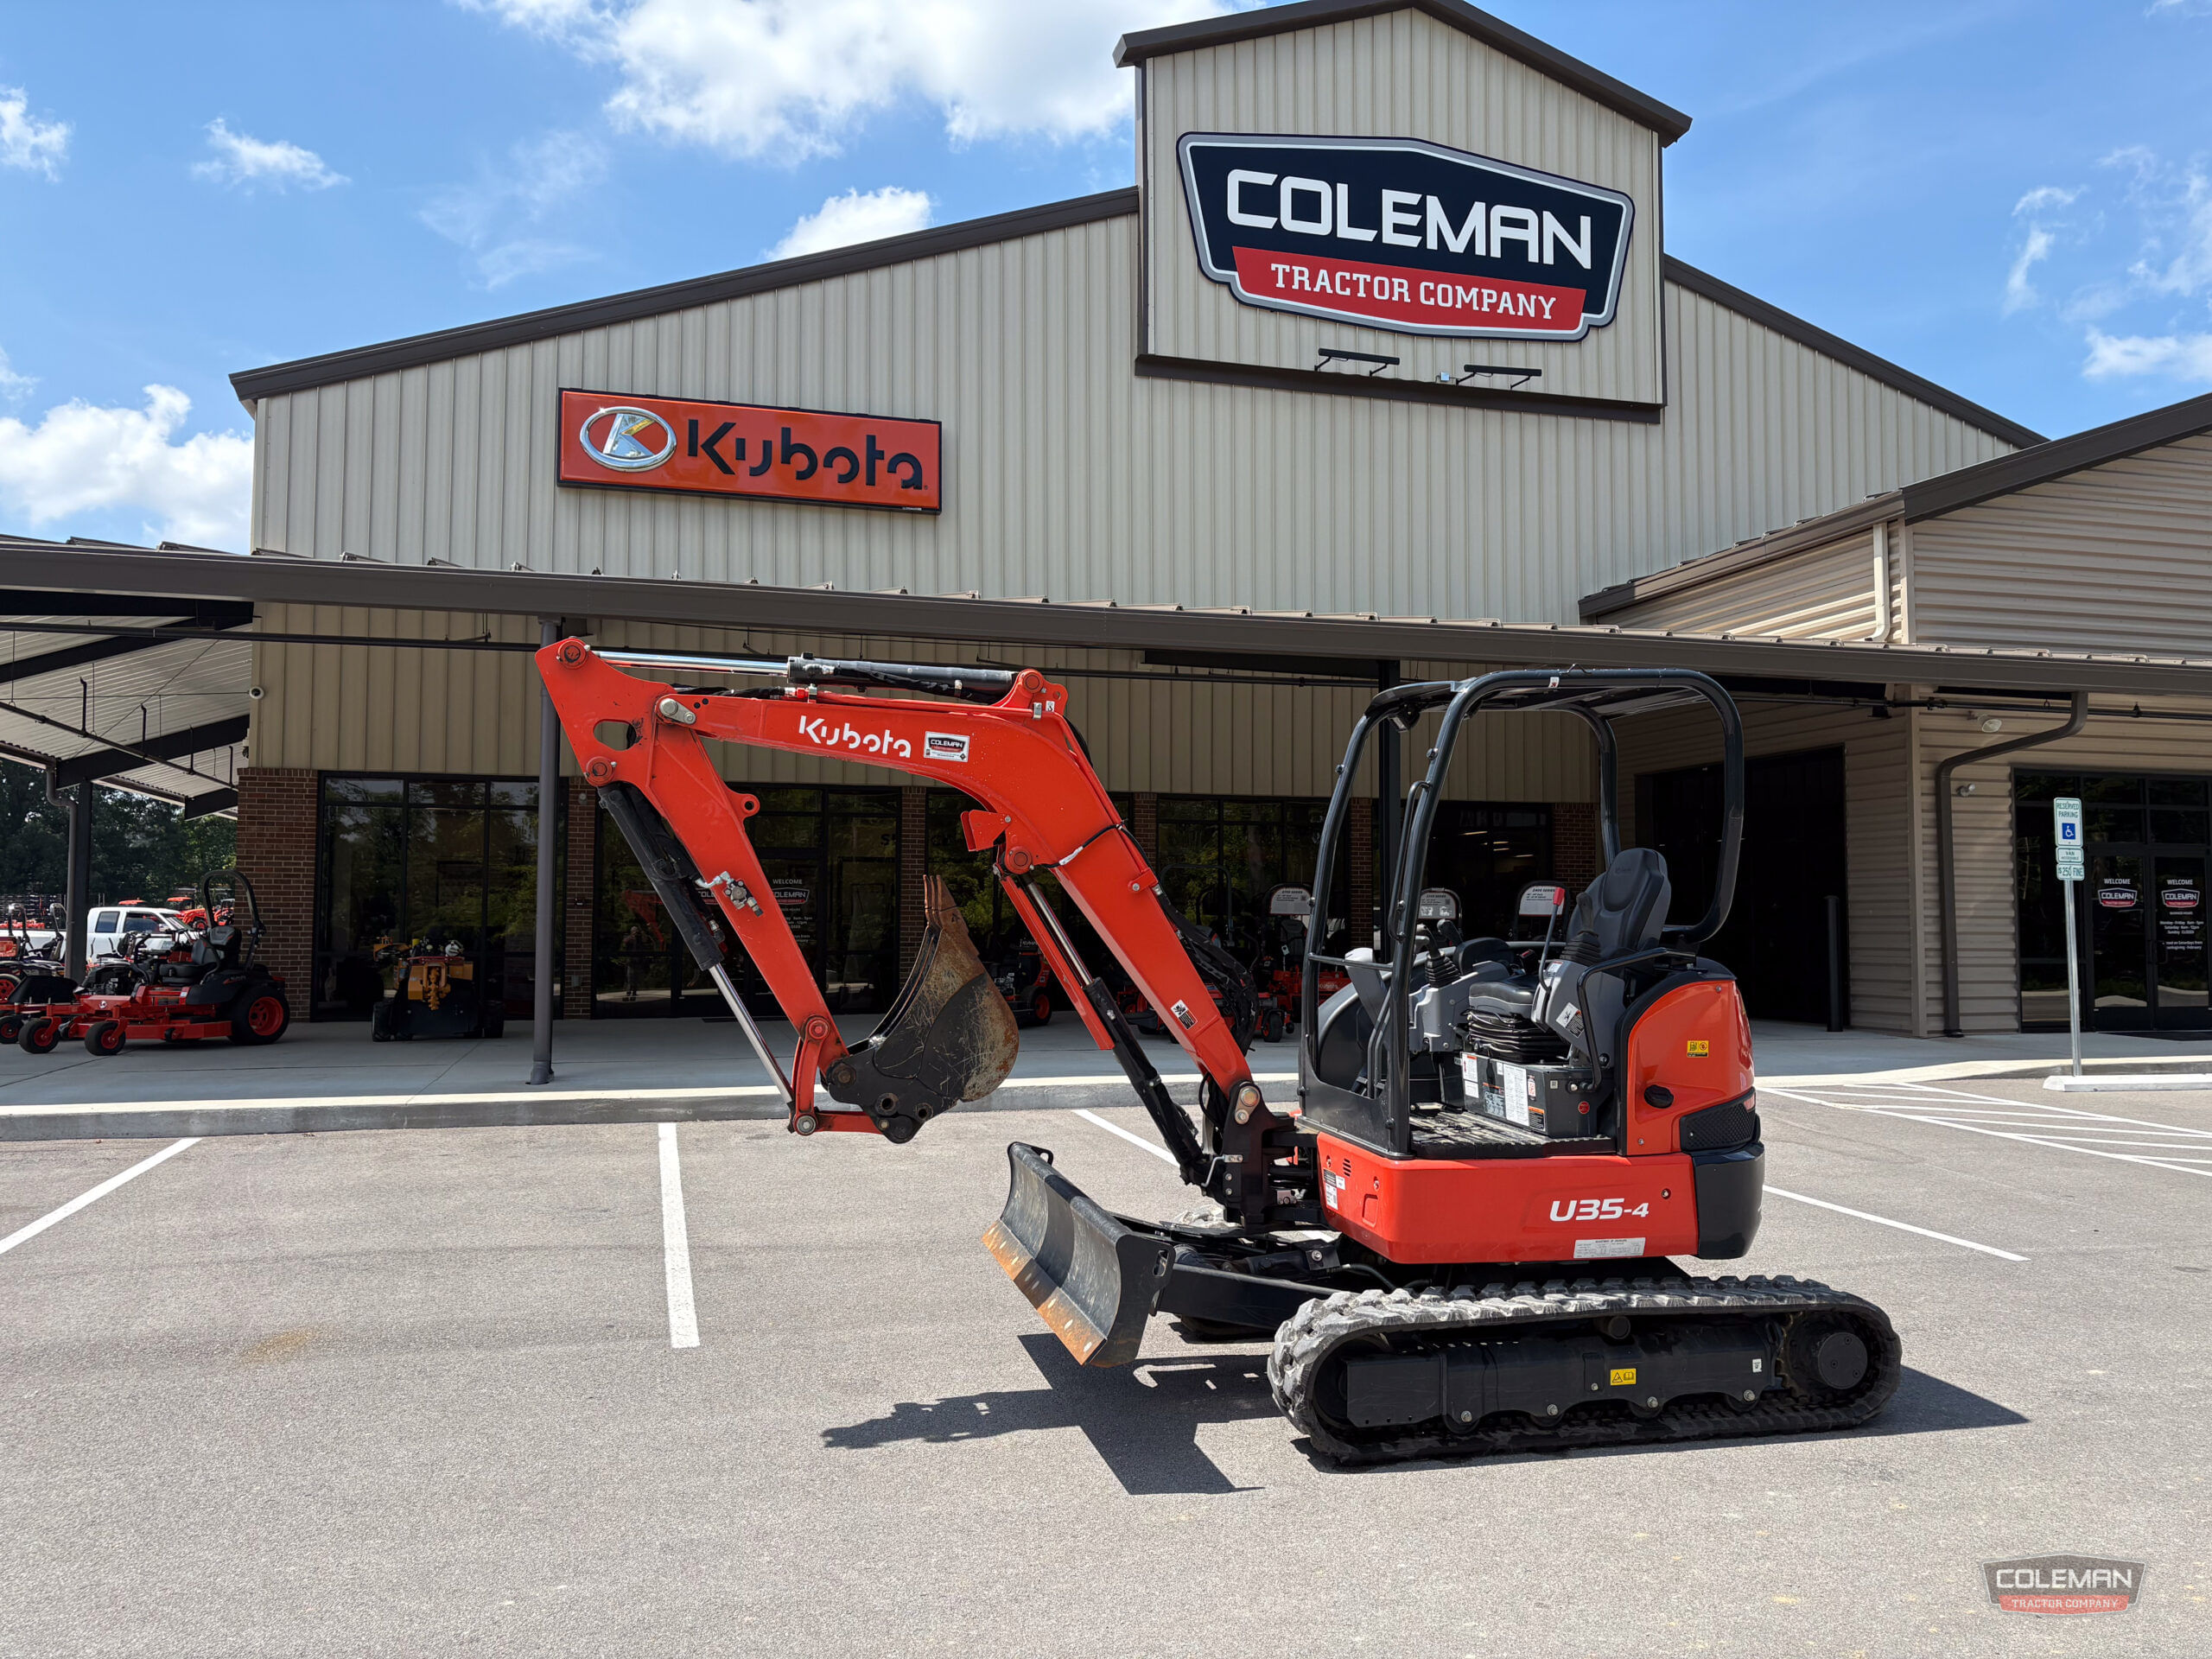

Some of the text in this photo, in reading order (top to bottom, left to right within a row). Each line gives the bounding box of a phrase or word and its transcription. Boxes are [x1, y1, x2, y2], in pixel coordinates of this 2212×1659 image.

[1227, 168, 1592, 270] COLEMAN
[1270, 263, 1557, 320] TRACTOR COMPANY
[688, 418, 924, 490] Kubota
[798, 715, 912, 758] Kubota
[930, 739, 963, 748] COLEMAN
[2073, 867, 2083, 877] FINE
[1549, 1198, 1649, 1222] U35-4
